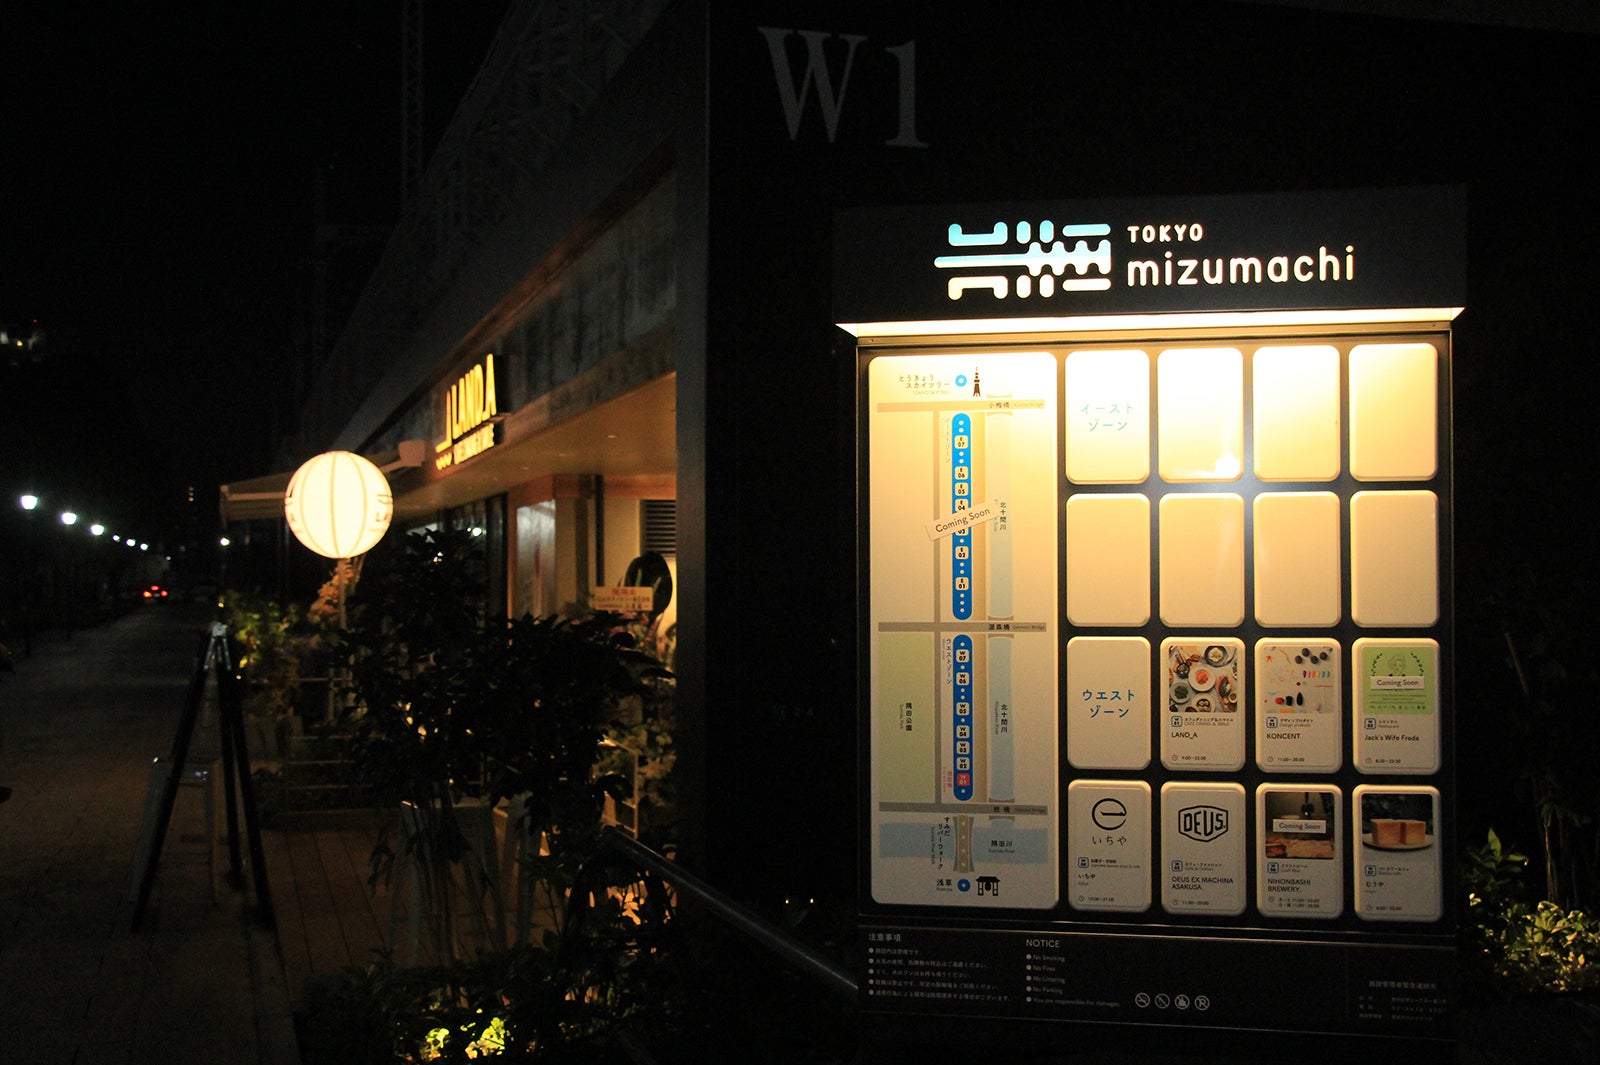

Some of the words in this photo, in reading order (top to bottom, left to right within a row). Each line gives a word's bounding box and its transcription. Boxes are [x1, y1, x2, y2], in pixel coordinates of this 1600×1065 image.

[1127, 223, 1203, 243] TOKYO
[1127, 245, 1354, 287] mizumachi
[1080, 402, 1134, 415] イースト
[1089, 418, 1128, 432] ゾーン
[935, 517, 968, 533] Coming
[969, 508, 990, 520] Soon
[1376, 680, 1402, 688] Coming
[1082, 689, 1134, 701] ウエスト
[1090, 704, 1129, 718] ゾーン
[1184, 810, 1224, 836] DEUS
[1092, 836, 1127, 846] いちや
[868, 933, 902, 942] 注意事項
[1026, 939, 1061, 948] NOTICE
